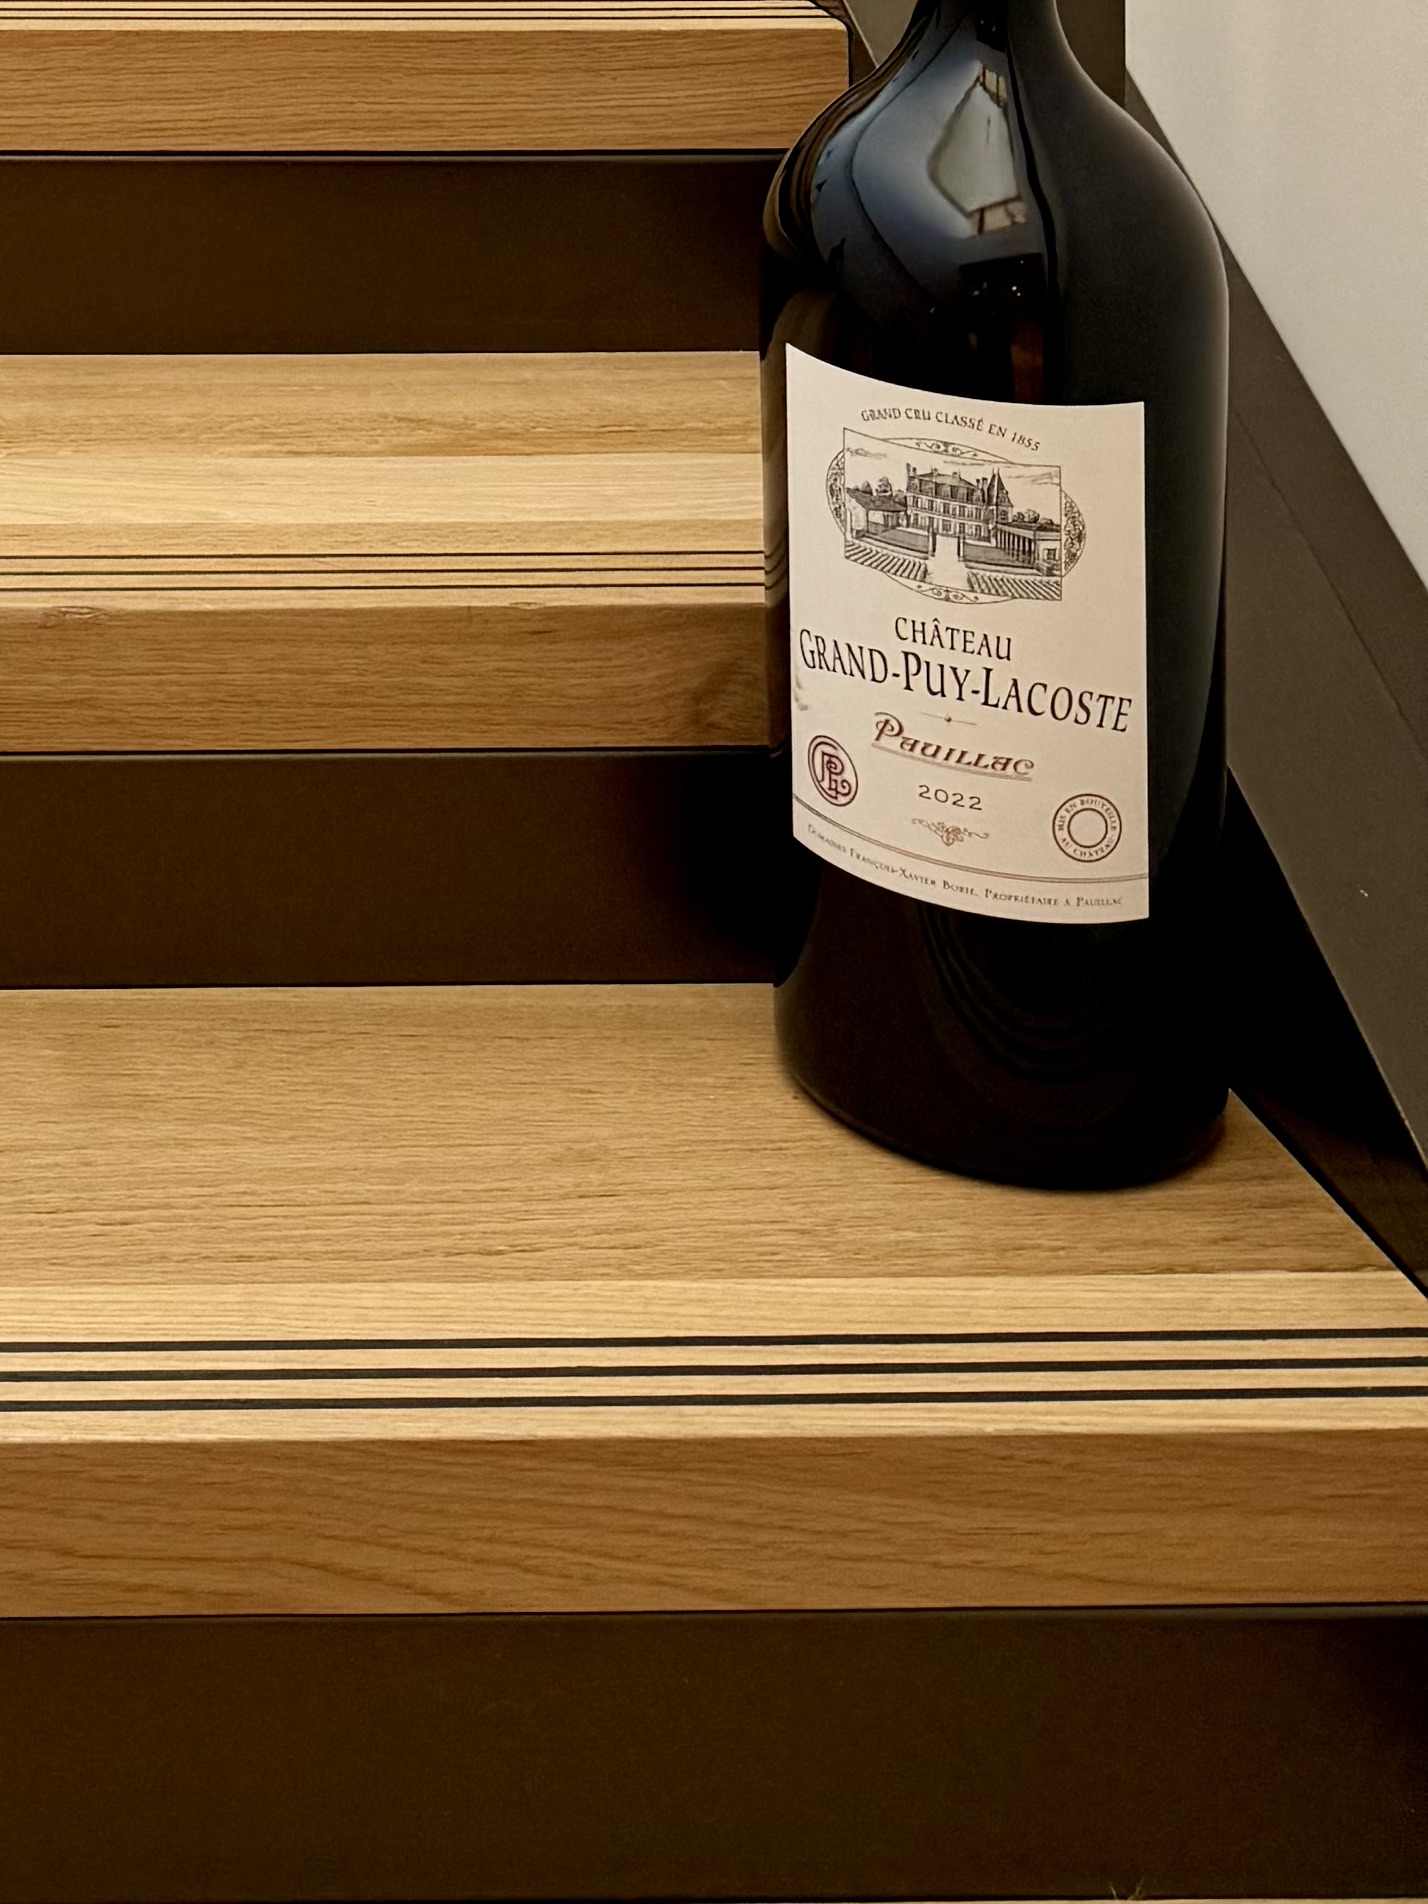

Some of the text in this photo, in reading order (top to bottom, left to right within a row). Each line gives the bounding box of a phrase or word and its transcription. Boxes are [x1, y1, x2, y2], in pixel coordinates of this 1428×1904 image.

[861, 407, 1041, 452] GRAND CRU CLASSÉ EN 1855
[894, 616, 1012, 662] CHÂTEAU
[799, 628, 1133, 733] GRAND-PUY-LACOSTE
[918, 784, 983, 811] 2022
